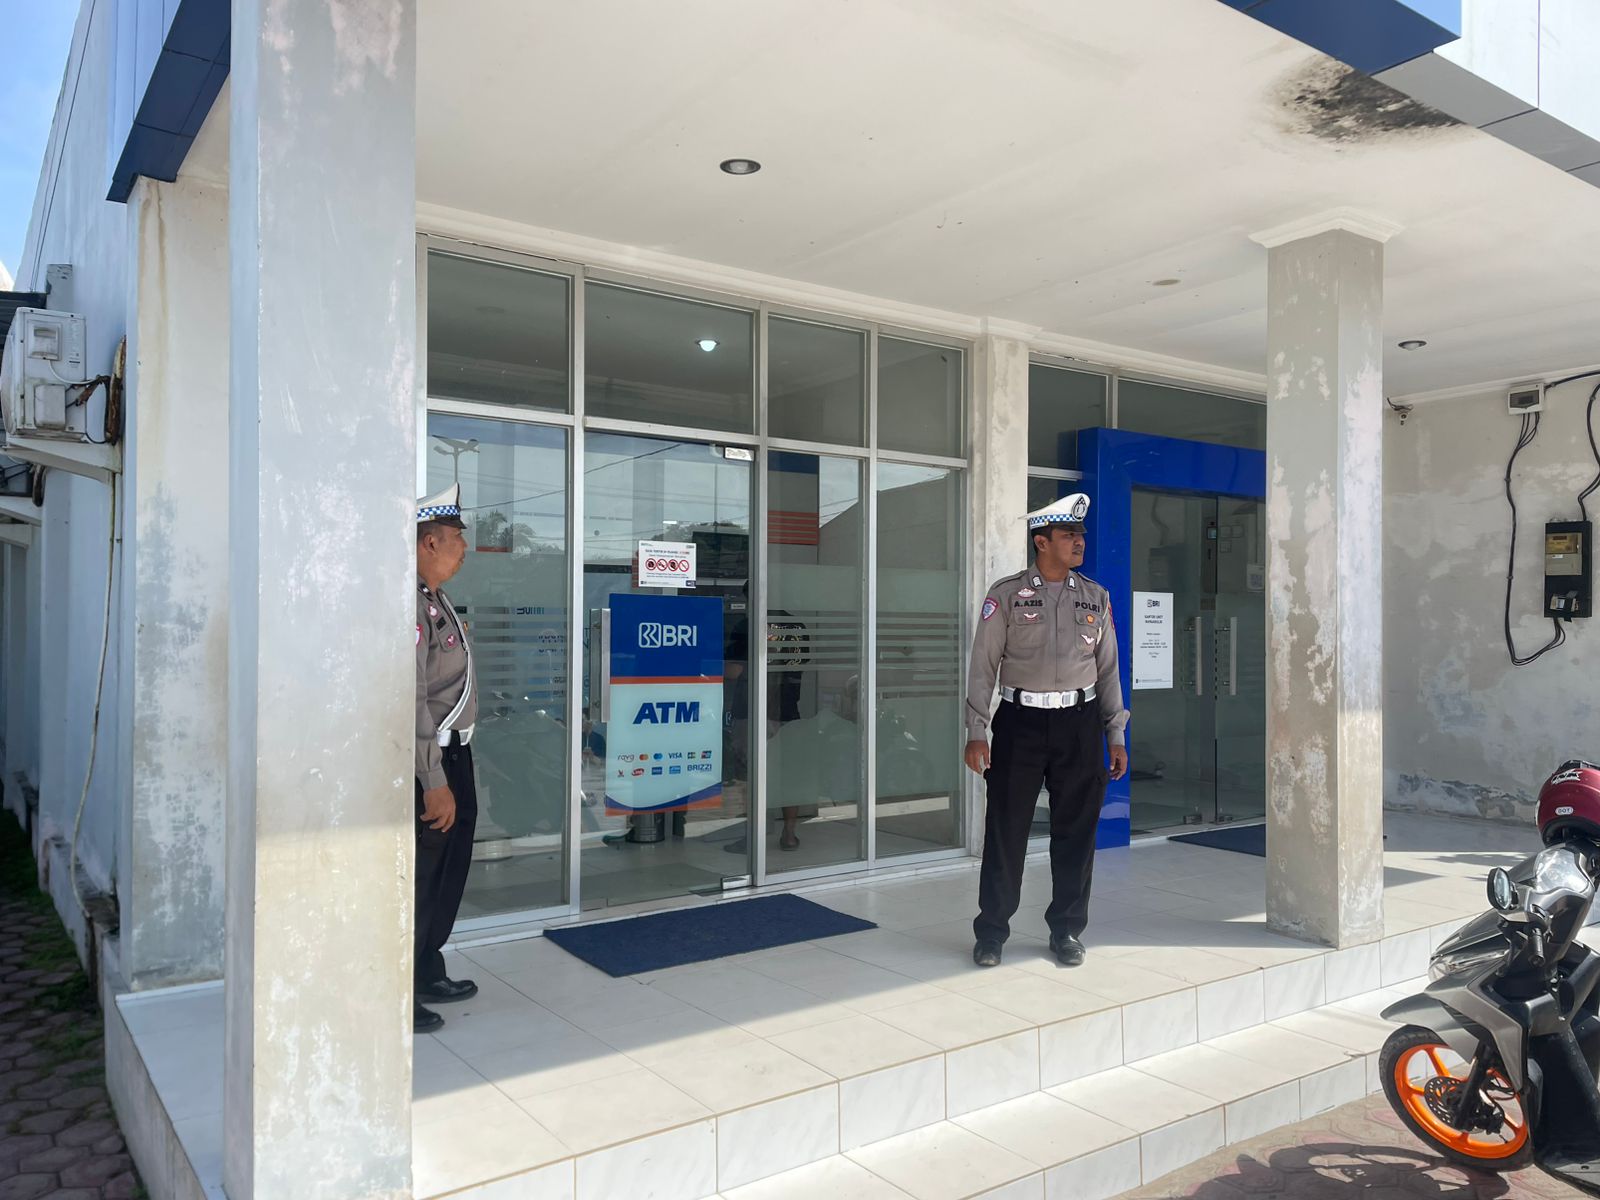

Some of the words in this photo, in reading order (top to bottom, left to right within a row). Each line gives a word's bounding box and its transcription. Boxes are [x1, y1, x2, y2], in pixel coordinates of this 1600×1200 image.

[1014, 600, 1043, 608] A.AZIS
[1075, 601, 1100, 613] POLRI
[662, 624, 698, 647] BRI
[632, 701, 700, 725] ATM
[687, 763, 712, 772] BRIZZI
